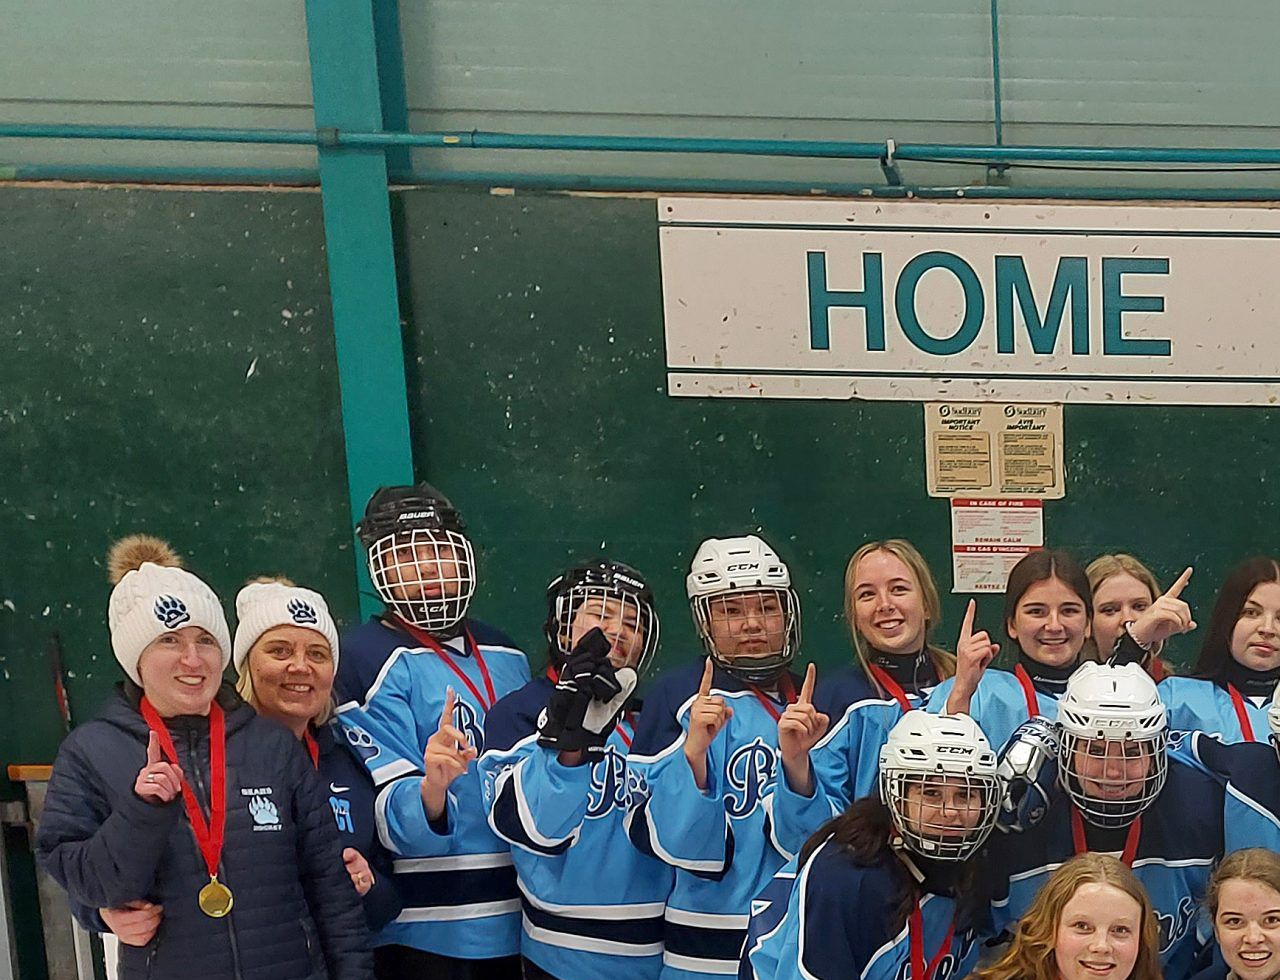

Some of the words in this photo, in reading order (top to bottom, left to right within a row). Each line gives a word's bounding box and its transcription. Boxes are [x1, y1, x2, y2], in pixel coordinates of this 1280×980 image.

[805, 250, 1172, 357] HOME
[399, 511, 435, 520] BAUER
[726, 562, 760, 572] CCM
[936, 746, 974, 755] CCM
